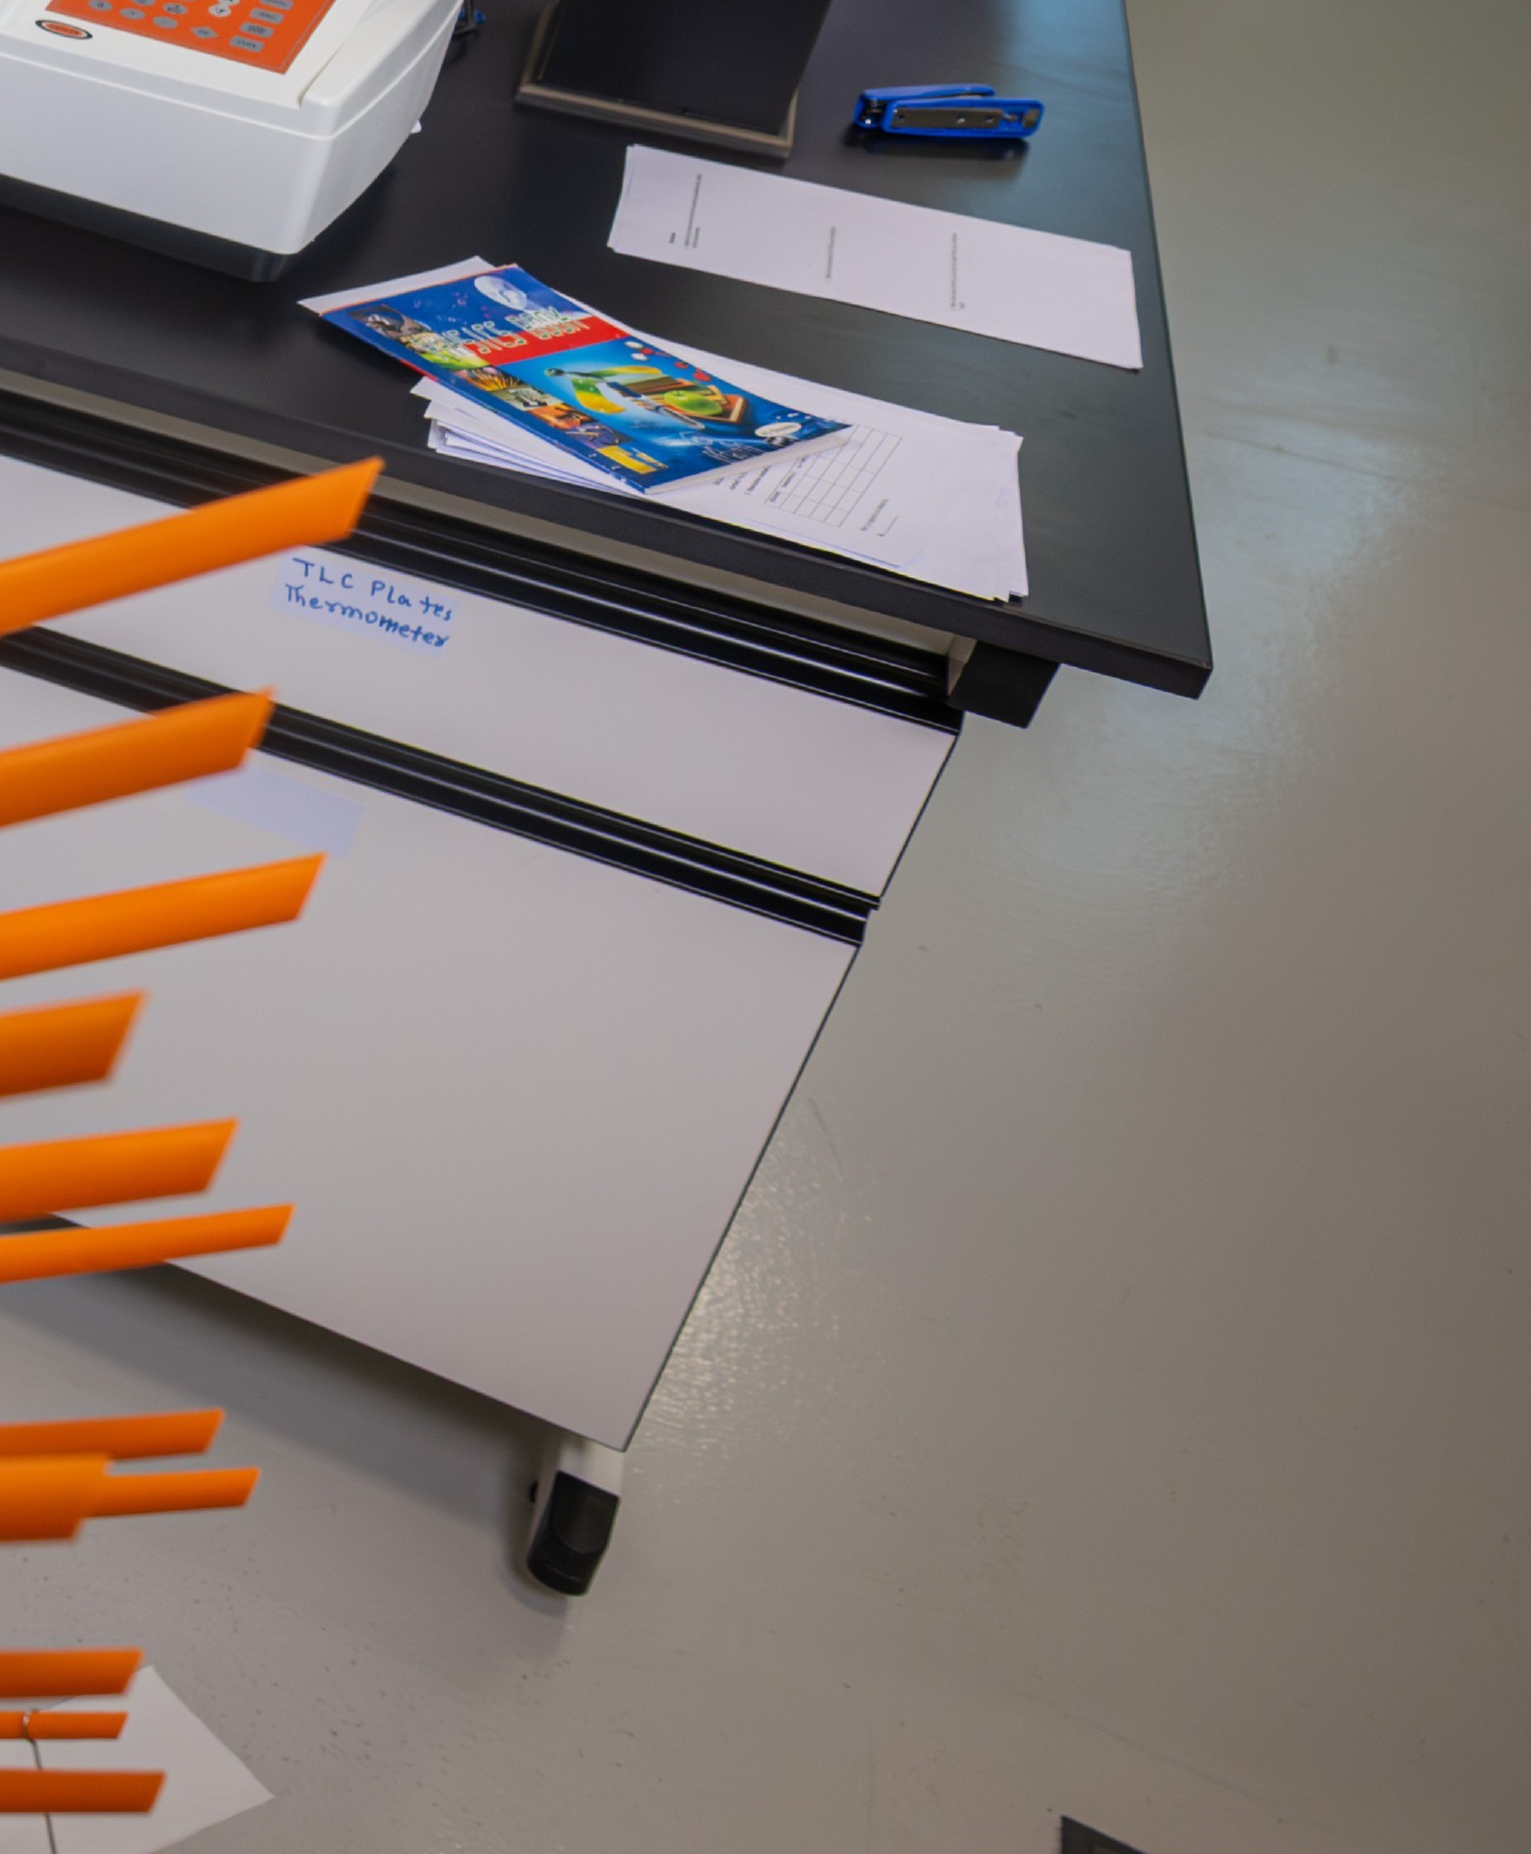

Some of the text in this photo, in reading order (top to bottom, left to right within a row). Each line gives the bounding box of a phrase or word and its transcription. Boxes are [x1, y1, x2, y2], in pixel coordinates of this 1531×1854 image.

[285, 583, 450, 647] Thermometer
[292, 557, 453, 622] TLC Plates
